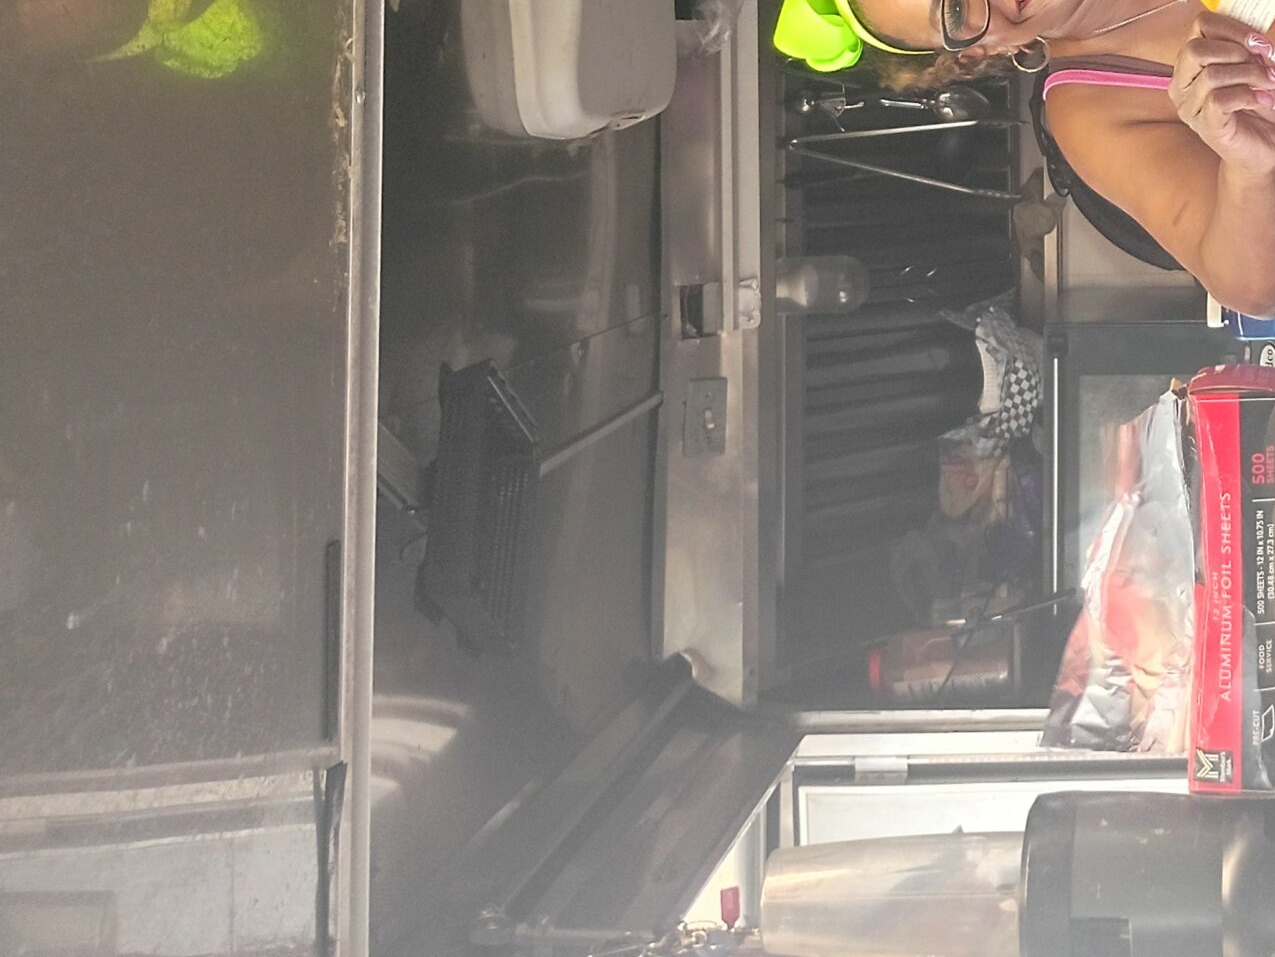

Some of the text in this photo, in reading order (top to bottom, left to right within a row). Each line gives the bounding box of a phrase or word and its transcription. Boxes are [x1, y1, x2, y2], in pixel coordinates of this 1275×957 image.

[1251, 452, 1265, 484] 500
[1266, 445, 1275, 484] SHEETS
[1256, 510, 1264, 519] IN
[1256, 520, 1264, 539] 10.75
[1267, 523, 1275, 538] cm)
[1256, 546, 1264, 555] IN
[1256, 556, 1264, 565] 12
[1268, 562, 1274, 574] cm
[1256, 570, 1264, 598] SHEETS
[1267, 574, 1275, 600] (30.48
[1219, 492, 1232, 701] ALUMINUM FOIL SHEETS
[1256, 600, 1264, 614] 500
[1258, 644, 1266, 669] FOOD
[1252, 710, 1260, 746] PRE-CUT
